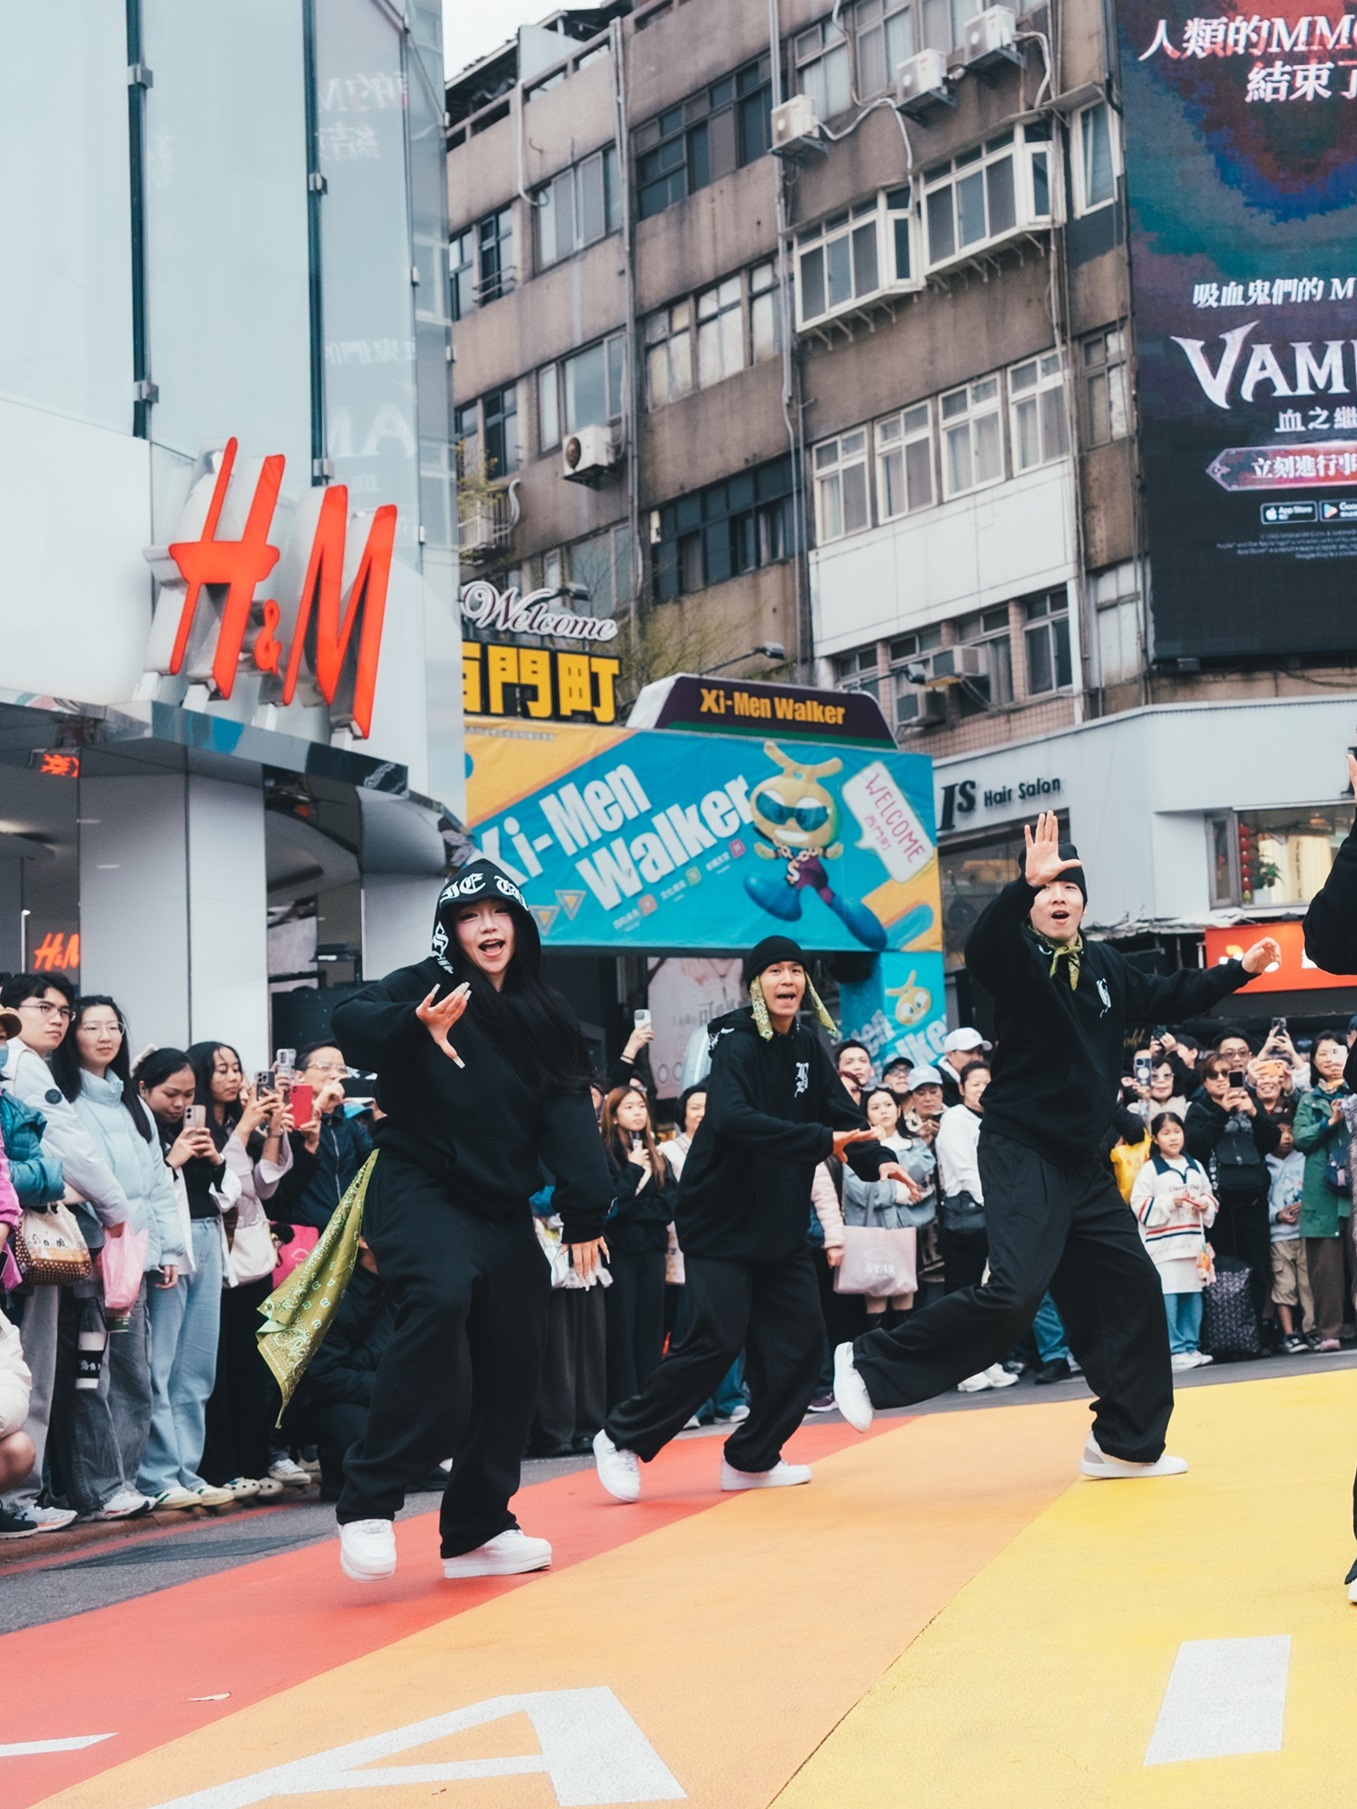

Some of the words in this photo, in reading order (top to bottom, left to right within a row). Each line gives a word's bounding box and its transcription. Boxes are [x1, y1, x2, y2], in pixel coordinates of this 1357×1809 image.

[1193, 277, 1324, 309] 吸血鬼們的
[168, 436, 398, 740] H&M
[460, 580, 619, 641] Welcome
[700, 688, 772, 718] Xi-Men
[775, 696, 846, 725] Walker
[466, 763, 653, 887] Xi-Men
[864, 770, 929, 864] WELCOME
[984, 786, 1012, 807] Hair
[1018, 777, 1061, 800] Salon
[576, 774, 755, 912] Walker
